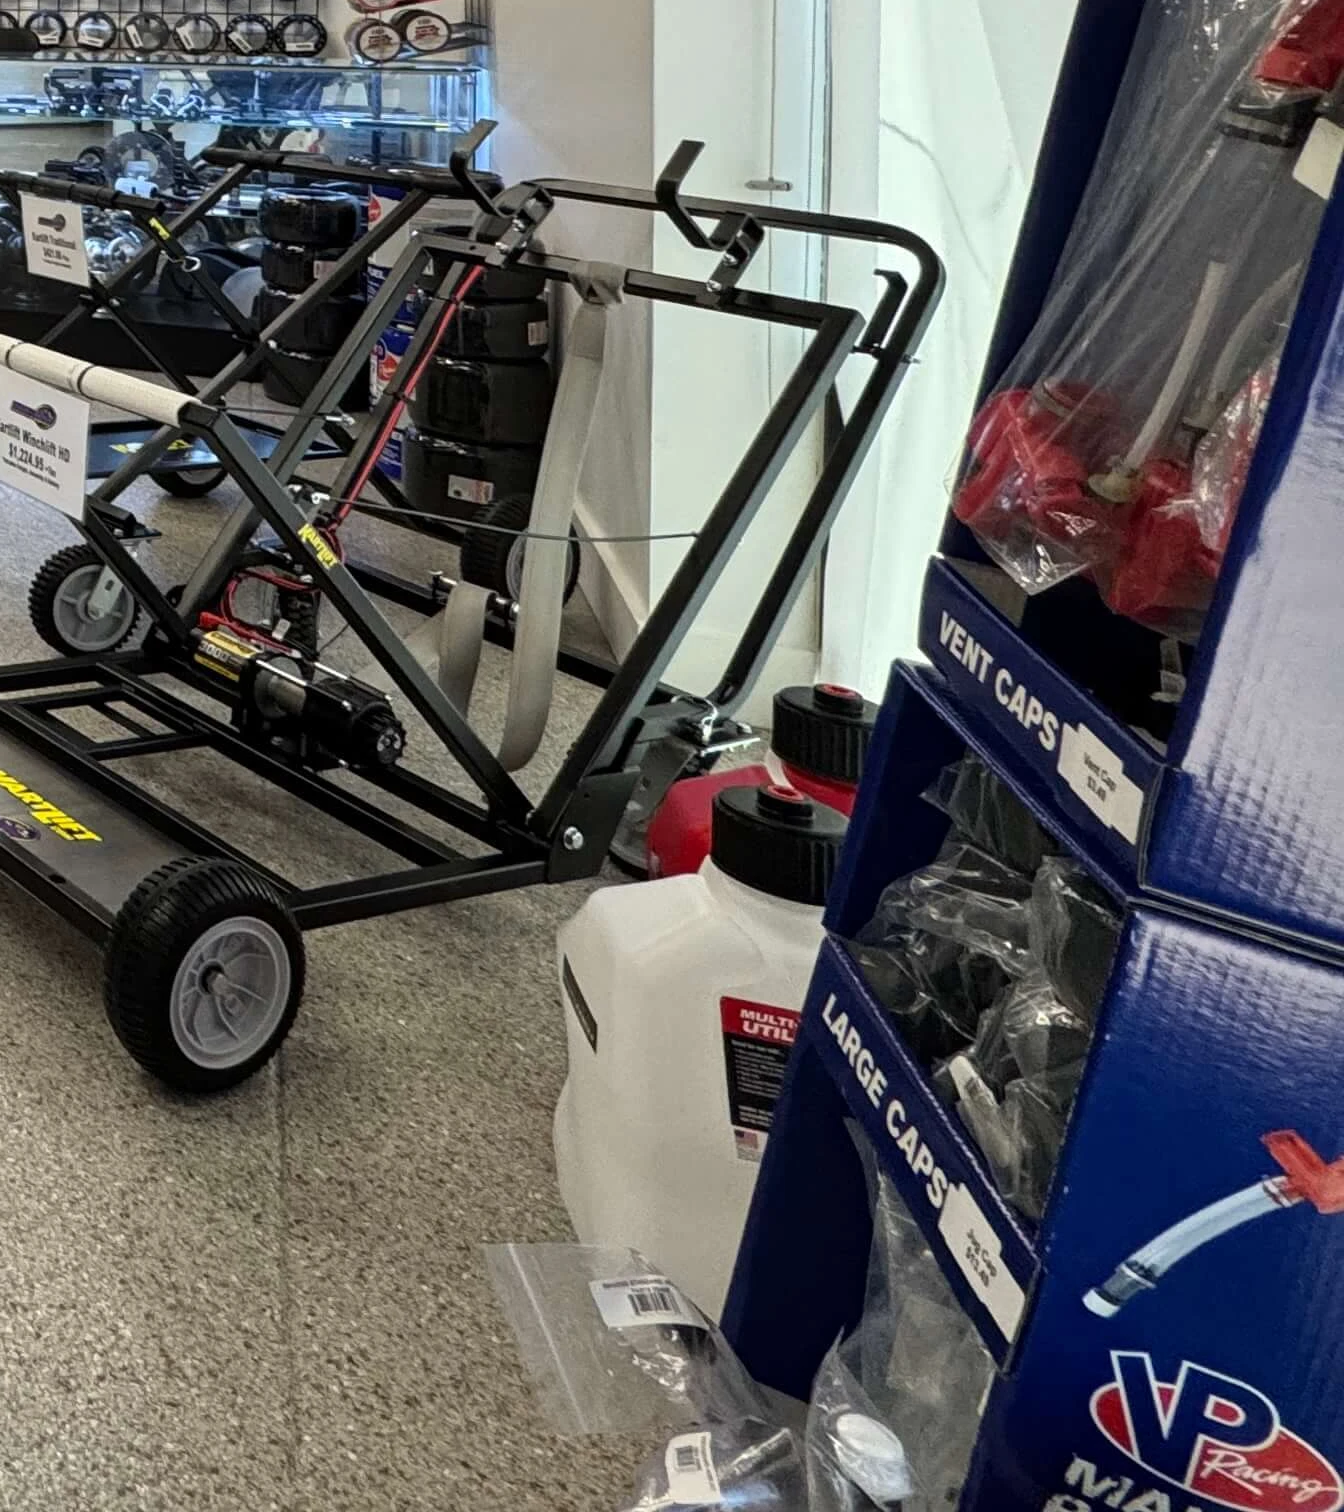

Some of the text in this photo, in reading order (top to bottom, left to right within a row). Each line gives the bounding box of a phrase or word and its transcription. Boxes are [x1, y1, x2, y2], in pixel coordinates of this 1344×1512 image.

[939, 610, 1059, 752] VENT CAPS
[1083, 751, 1100, 777] Vent
[822, 993, 952, 1210] LARGE CAPS
[1110, 1350, 1280, 1489] VP
[1200, 1448, 1338, 1503] Racing
